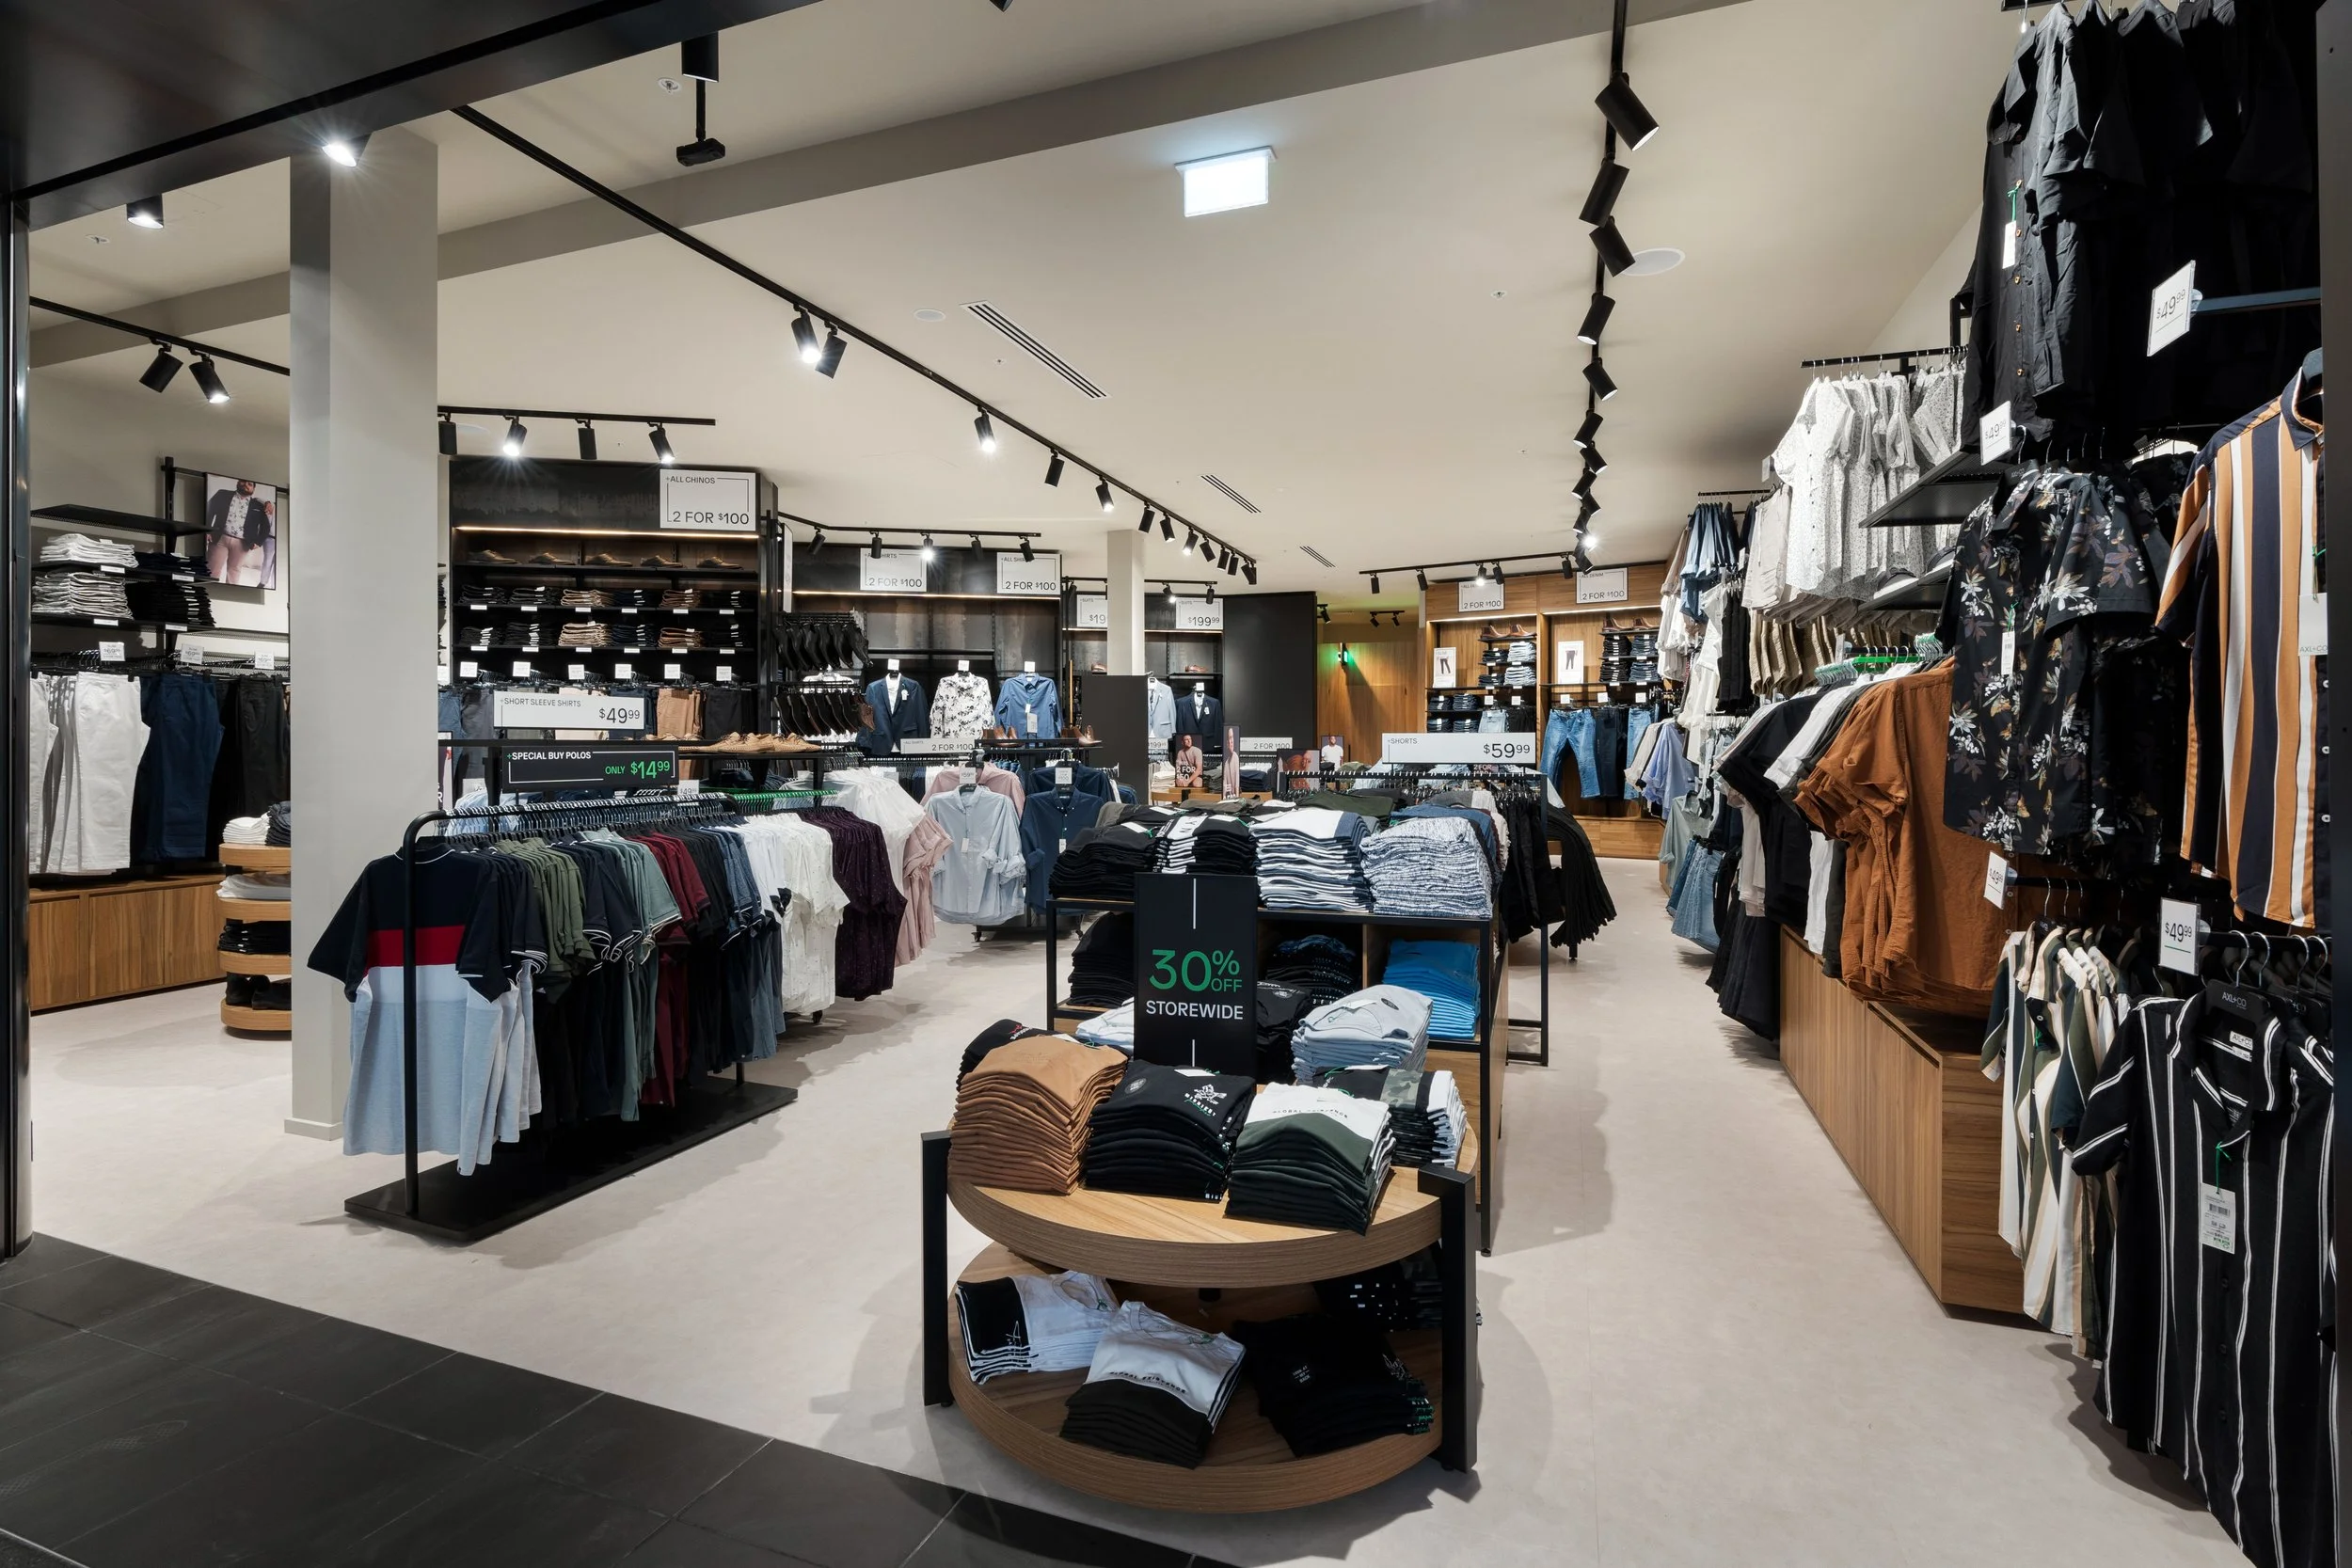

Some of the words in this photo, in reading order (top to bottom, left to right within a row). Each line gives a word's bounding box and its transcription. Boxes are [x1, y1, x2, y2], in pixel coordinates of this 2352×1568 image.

[685, 476, 716, 484] CHINOS
[672, 511, 681, 523] 2
[685, 511, 714, 524] FOR
[718, 513, 750, 525] $100
[868, 578, 875, 586] 2
[877, 578, 898, 587] FOR
[900, 578, 923, 588] $100
[1006, 580, 1012, 590] 2
[1013, 580, 1033, 591] FOR
[1036, 581, 1057, 592] $100
[1588, 592, 1605, 600] FOR
[1607, 590, 1626, 599] $100
[1470, 601, 1484, 610] FOR
[531, 698, 556, 706] SLEEVE
[548, 752, 564, 760] BUY
[565, 751, 592, 760] POLOS
[605, 766, 626, 775] ONLY
[1149, 949, 1241, 992] 30%
[1211, 978, 1243, 993] OFF
[1146, 1000, 1244, 1021] STOREWIDE
